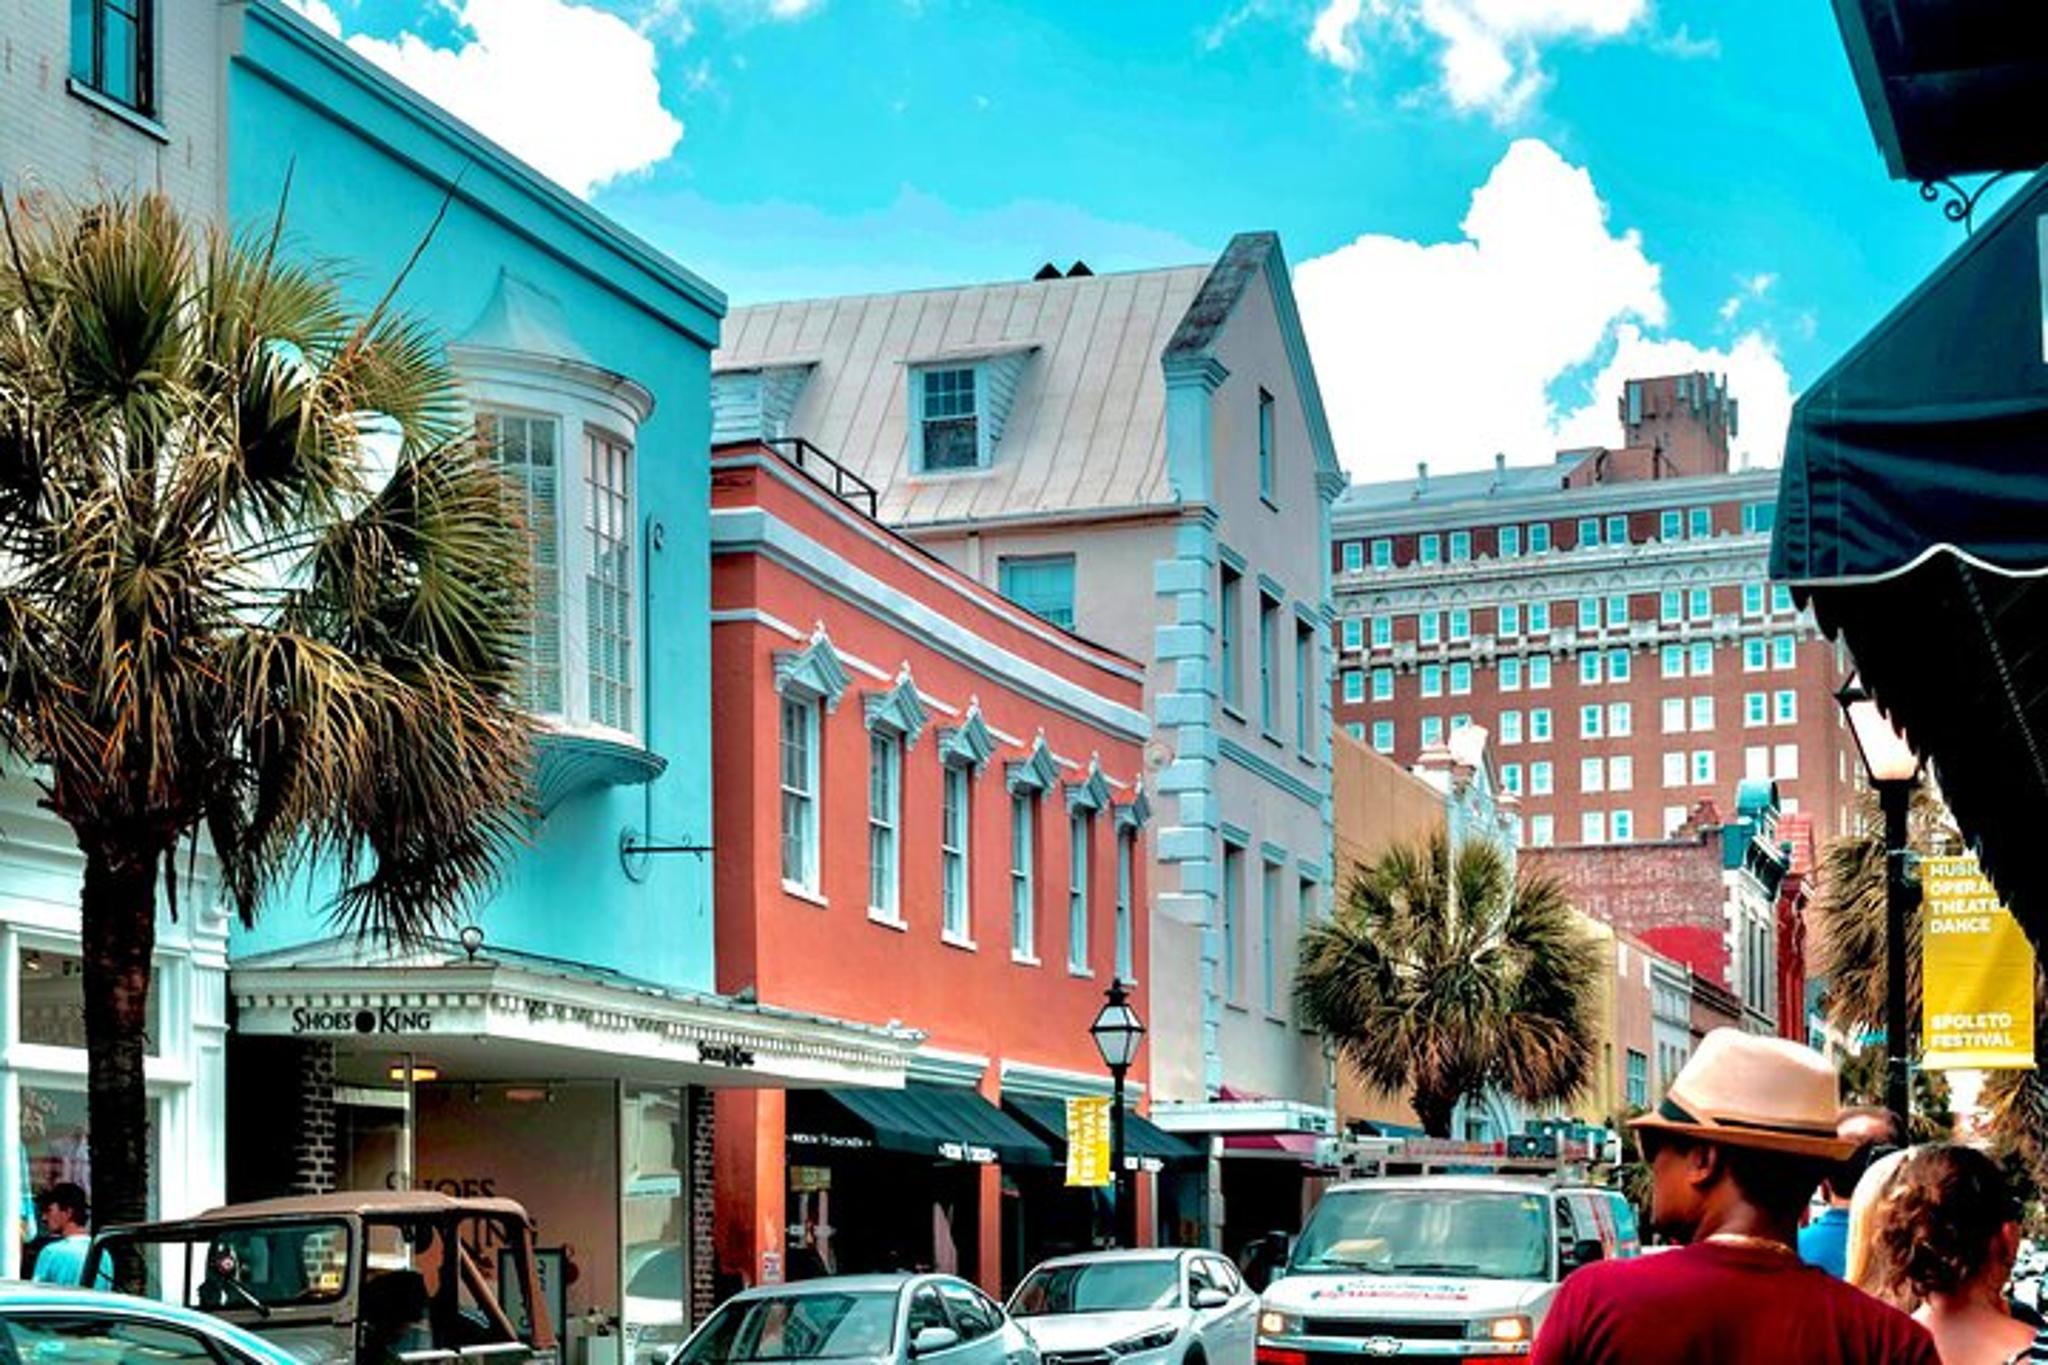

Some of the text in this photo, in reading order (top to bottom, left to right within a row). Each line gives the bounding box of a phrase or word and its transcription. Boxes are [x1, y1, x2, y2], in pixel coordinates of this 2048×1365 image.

[1930, 916, 1991, 933] DANCE
[292, 1006, 431, 1033] SHOES KING
[1931, 1012, 2013, 1030] SPOLETO
[1931, 1031, 2014, 1048] FESTIVAL
